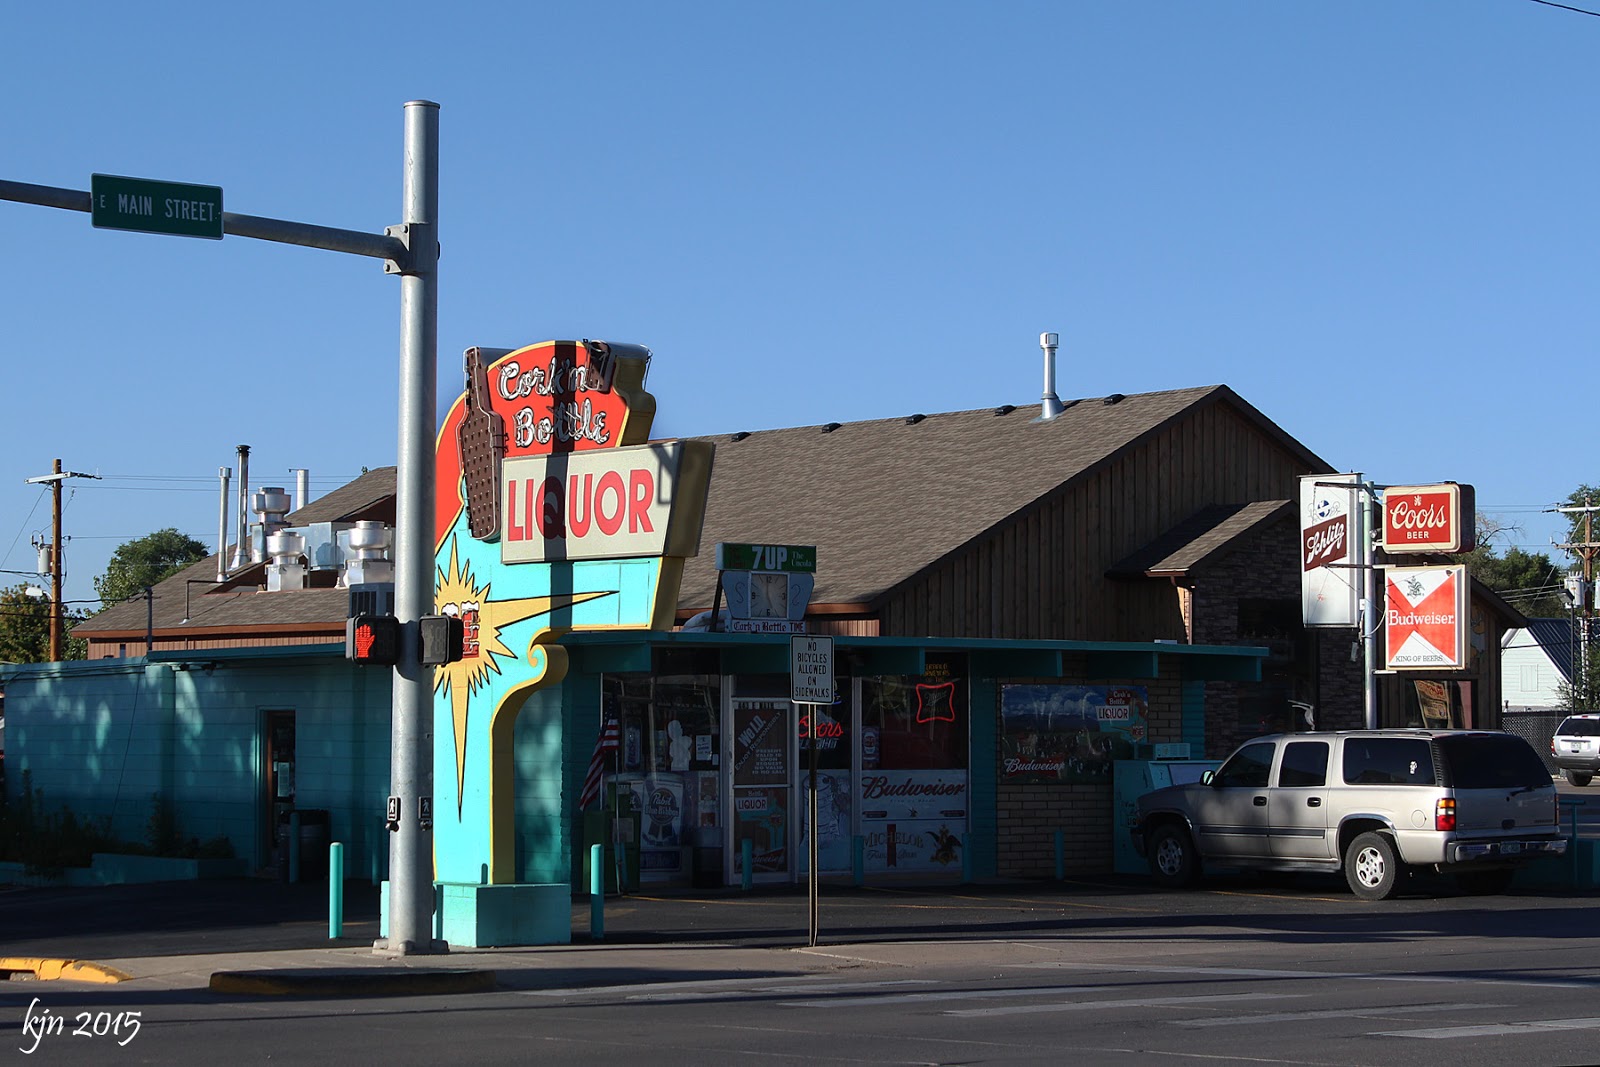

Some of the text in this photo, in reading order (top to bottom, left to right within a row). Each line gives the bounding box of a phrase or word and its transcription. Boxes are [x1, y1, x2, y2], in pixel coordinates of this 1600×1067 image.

[100, 193, 215, 222] E MAIN STREET
[497, 356, 589, 400] Cork'n
[514, 398, 610, 448] Bottle
[508, 469, 654, 541] LIQUOR
[1390, 501, 1447, 529] Coors
[1406, 531, 1430, 540] BEER
[1306, 522, 1345, 564] Schlitz
[752, 546, 787, 570] 7UP
[792, 551, 804, 559] The
[762, 621, 787, 631] Bottle
[789, 622, 804, 632] TIME
[808, 641, 817, 651] NO
[797, 652, 827, 664] BICYCLES
[798, 664, 827, 675] ALLOWED
[808, 676, 817, 686] ON
[795, 686, 829, 698] SIDEWALKS
[1109, 697, 1126, 705] Bottle
[1099, 708, 1128, 719] LIQUOR
[797, 715, 844, 738] Cors
[734, 751, 752, 771] ENJOY
[749, 712, 782, 751] RESPONSIBLY
[1004, 758, 1066, 772] Budweiser
[862, 775, 965, 799] Budweiser
[738, 800, 766, 809] LIQUOR
[863, 831, 923, 849] MICHELOB
